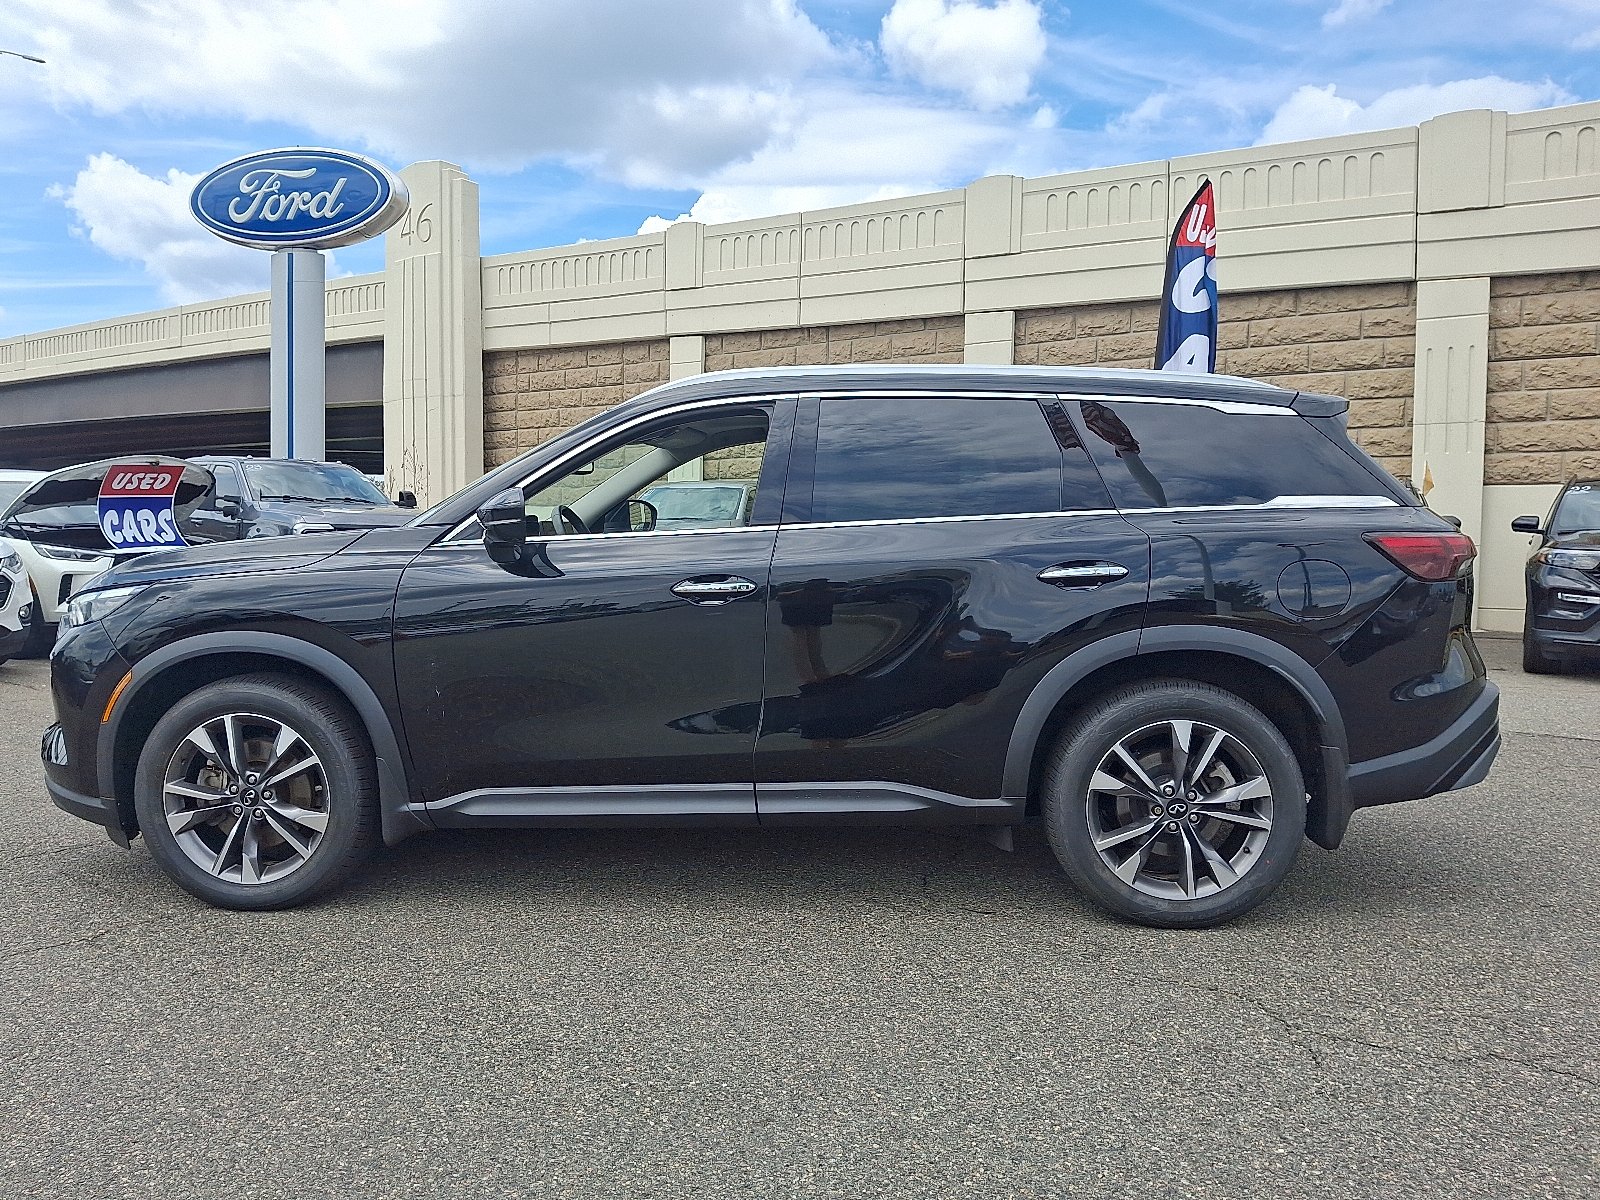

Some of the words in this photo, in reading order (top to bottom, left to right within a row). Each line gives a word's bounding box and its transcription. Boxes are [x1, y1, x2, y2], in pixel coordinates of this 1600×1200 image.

[228, 167, 347, 224] Ford
[400, 203, 433, 245] 46
[111, 472, 172, 490] USED
[103, 508, 176, 544] CARS
